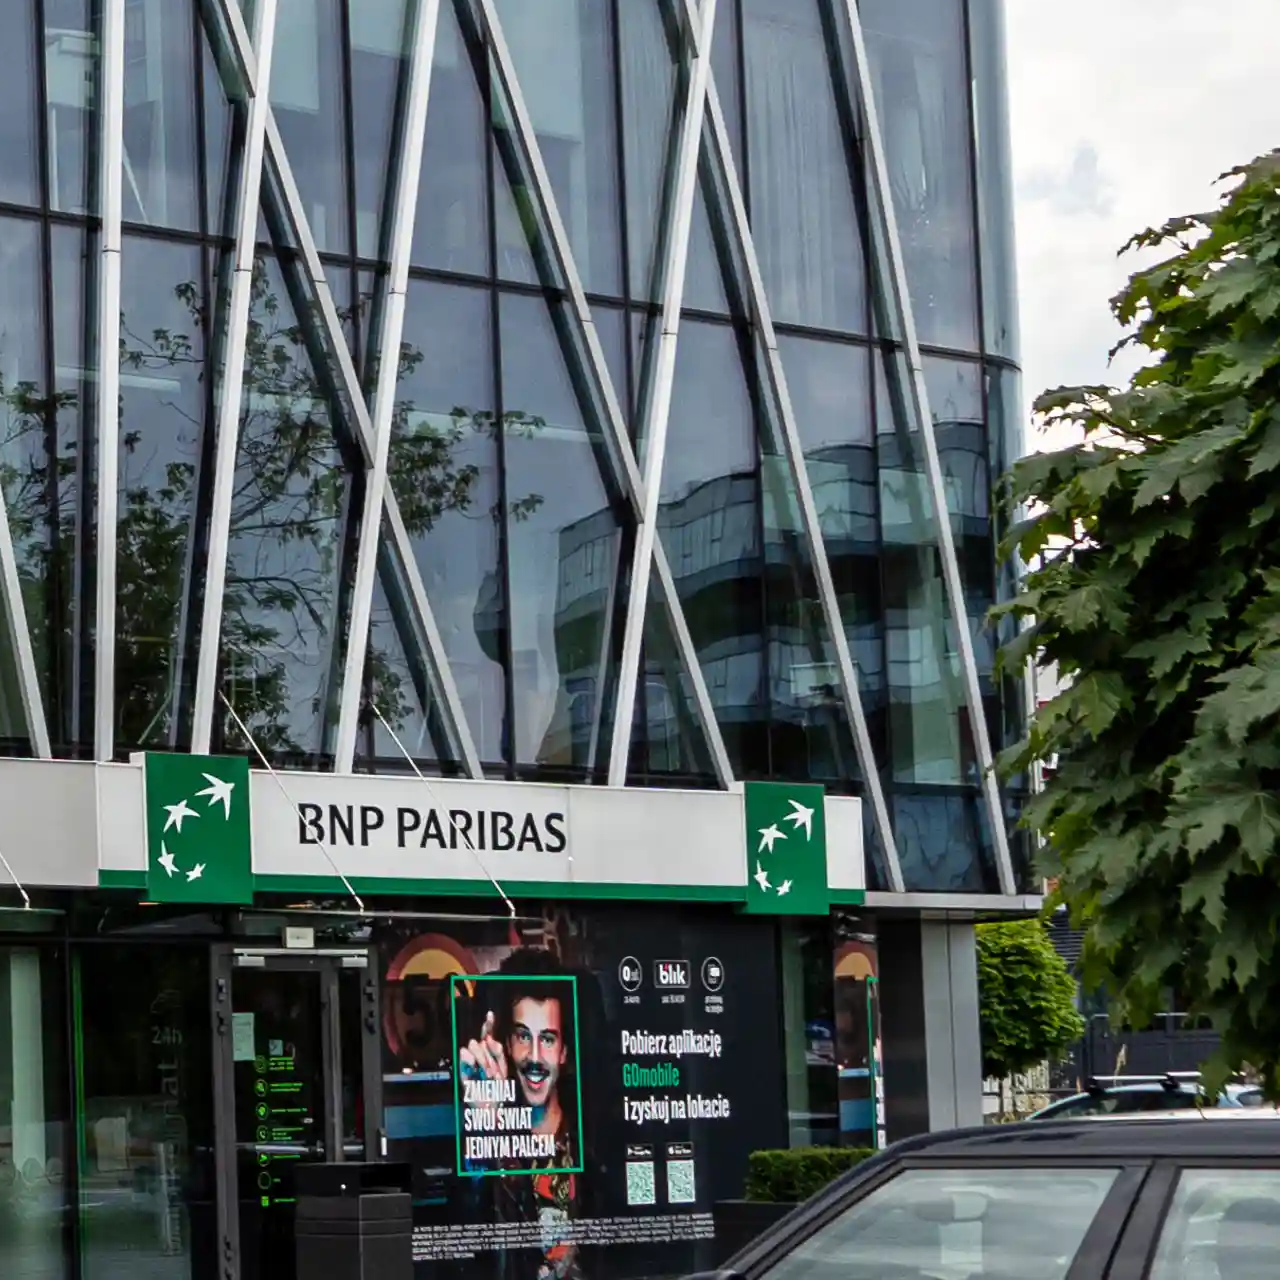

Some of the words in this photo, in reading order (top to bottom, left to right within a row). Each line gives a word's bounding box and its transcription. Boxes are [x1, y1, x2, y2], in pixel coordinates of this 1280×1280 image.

[298, 803, 384, 846] BNP
[397, 807, 567, 853] PARIBAS
[659, 962, 686, 985] blik
[621, 1029, 668, 1055] Pobierz
[669, 1029, 722, 1058] aplikację
[623, 1062, 680, 1088] GOmobile
[463, 1080, 515, 1102] ZMIENIAJ
[464, 1104, 495, 1131] SWÓJ
[498, 1102, 532, 1131] ŚWIAT
[624, 1096, 629, 1121] i
[630, 1095, 670, 1125] zyskuj
[671, 1100, 686, 1119] na
[687, 1093, 730, 1119] lokacie
[464, 1135, 510, 1159] JEDNYM
[511, 1134, 556, 1158] PALCEM
